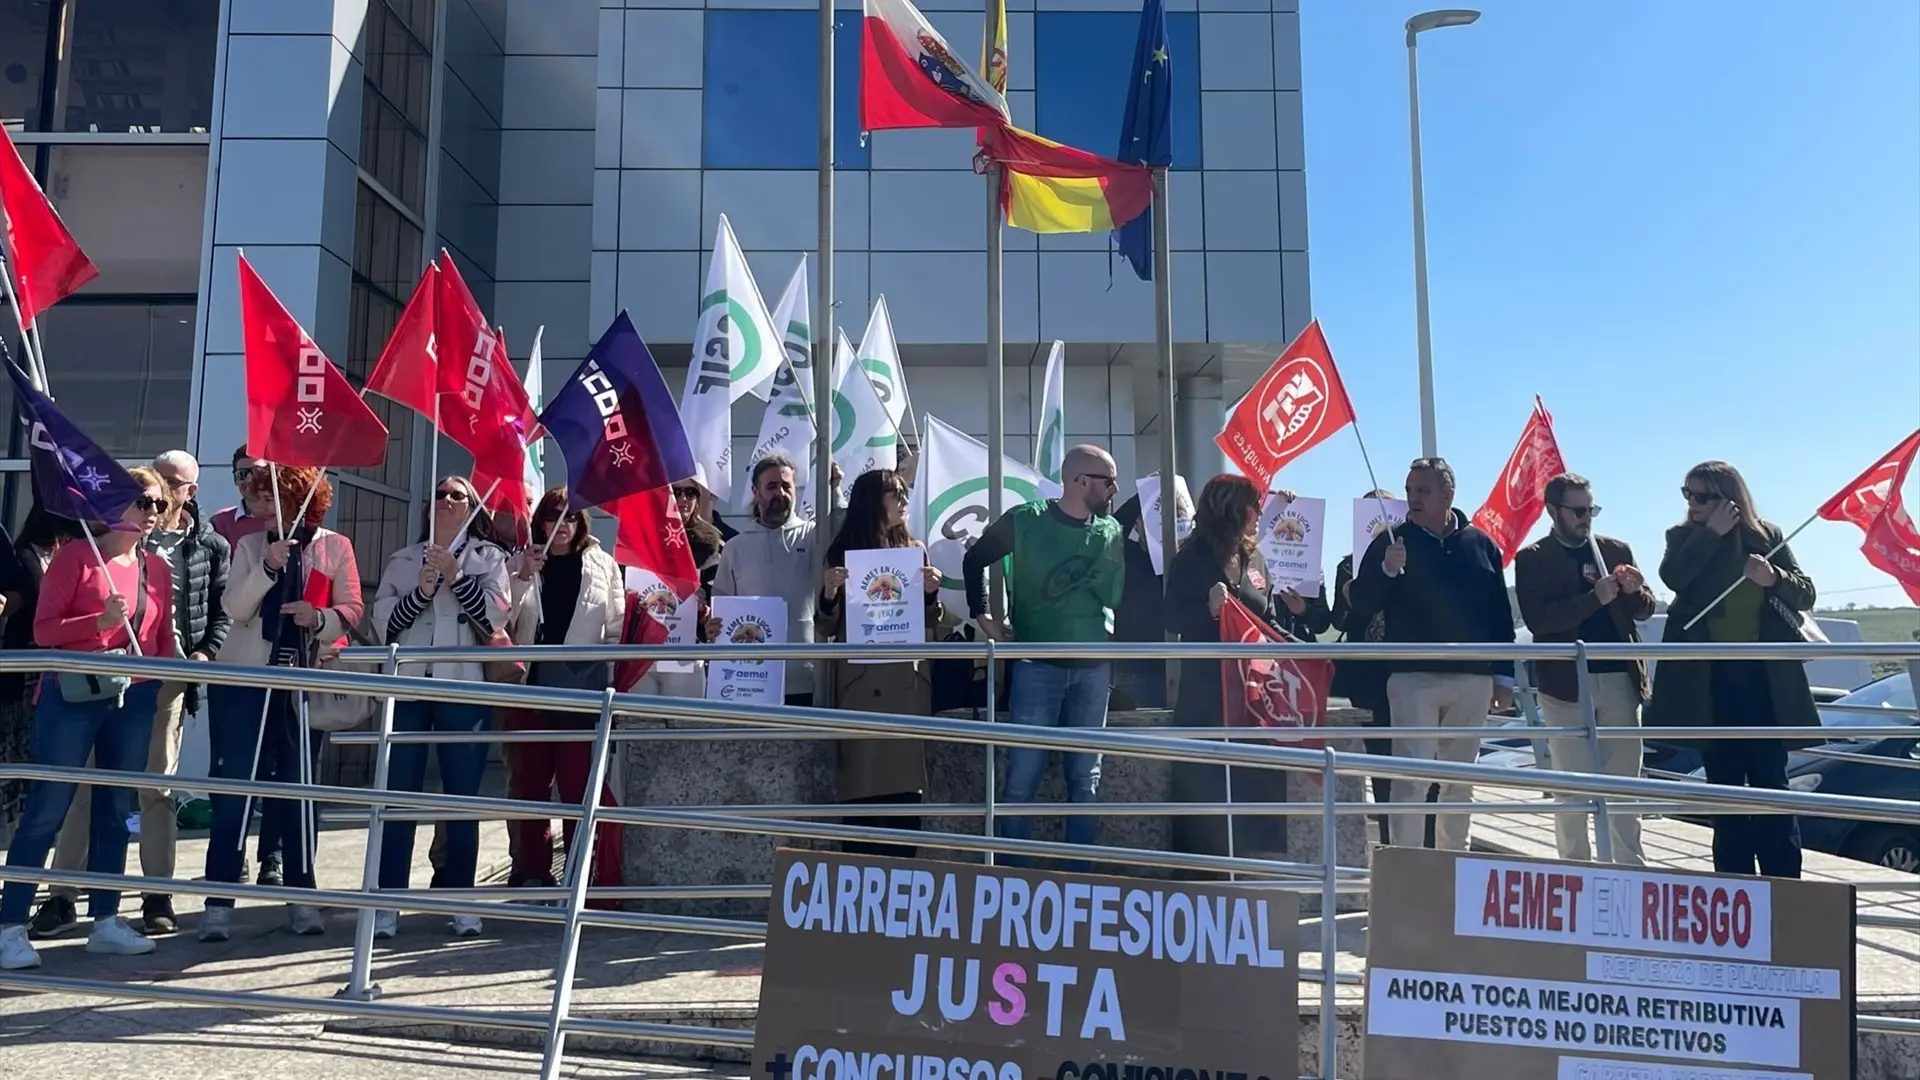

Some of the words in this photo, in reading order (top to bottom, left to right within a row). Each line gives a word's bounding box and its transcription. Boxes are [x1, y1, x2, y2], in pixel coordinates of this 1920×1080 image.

[875, 621, 910, 632] aemet
[736, 670, 769, 679] aemet
[783, 862, 959, 939] CARRERA
[971, 875, 1285, 968] PROFESIONAL
[1483, 868, 1583, 933] AEMET
[1592, 876, 1632, 937] EN
[1642, 881, 1752, 949] RIESGO
[892, 954, 1125, 1041] JUSTA
[1601, 956, 1695, 985] REFUERZO
[1700, 963, 1724, 988] DE
[1727, 966, 1825, 995] PLANTILLA
[1387, 977, 1465, 1004] AHORA
[1472, 983, 1532, 1010] TOCA
[1539, 989, 1630, 1018] MEJORA
[1636, 996, 1786, 1029] RETRIBUTIVA
[1444, 1011, 1548, 1040] PUESTOS
[1554, 1019, 1587, 1044] NO
[1593, 1023, 1728, 1054] DIRECTIVOS
